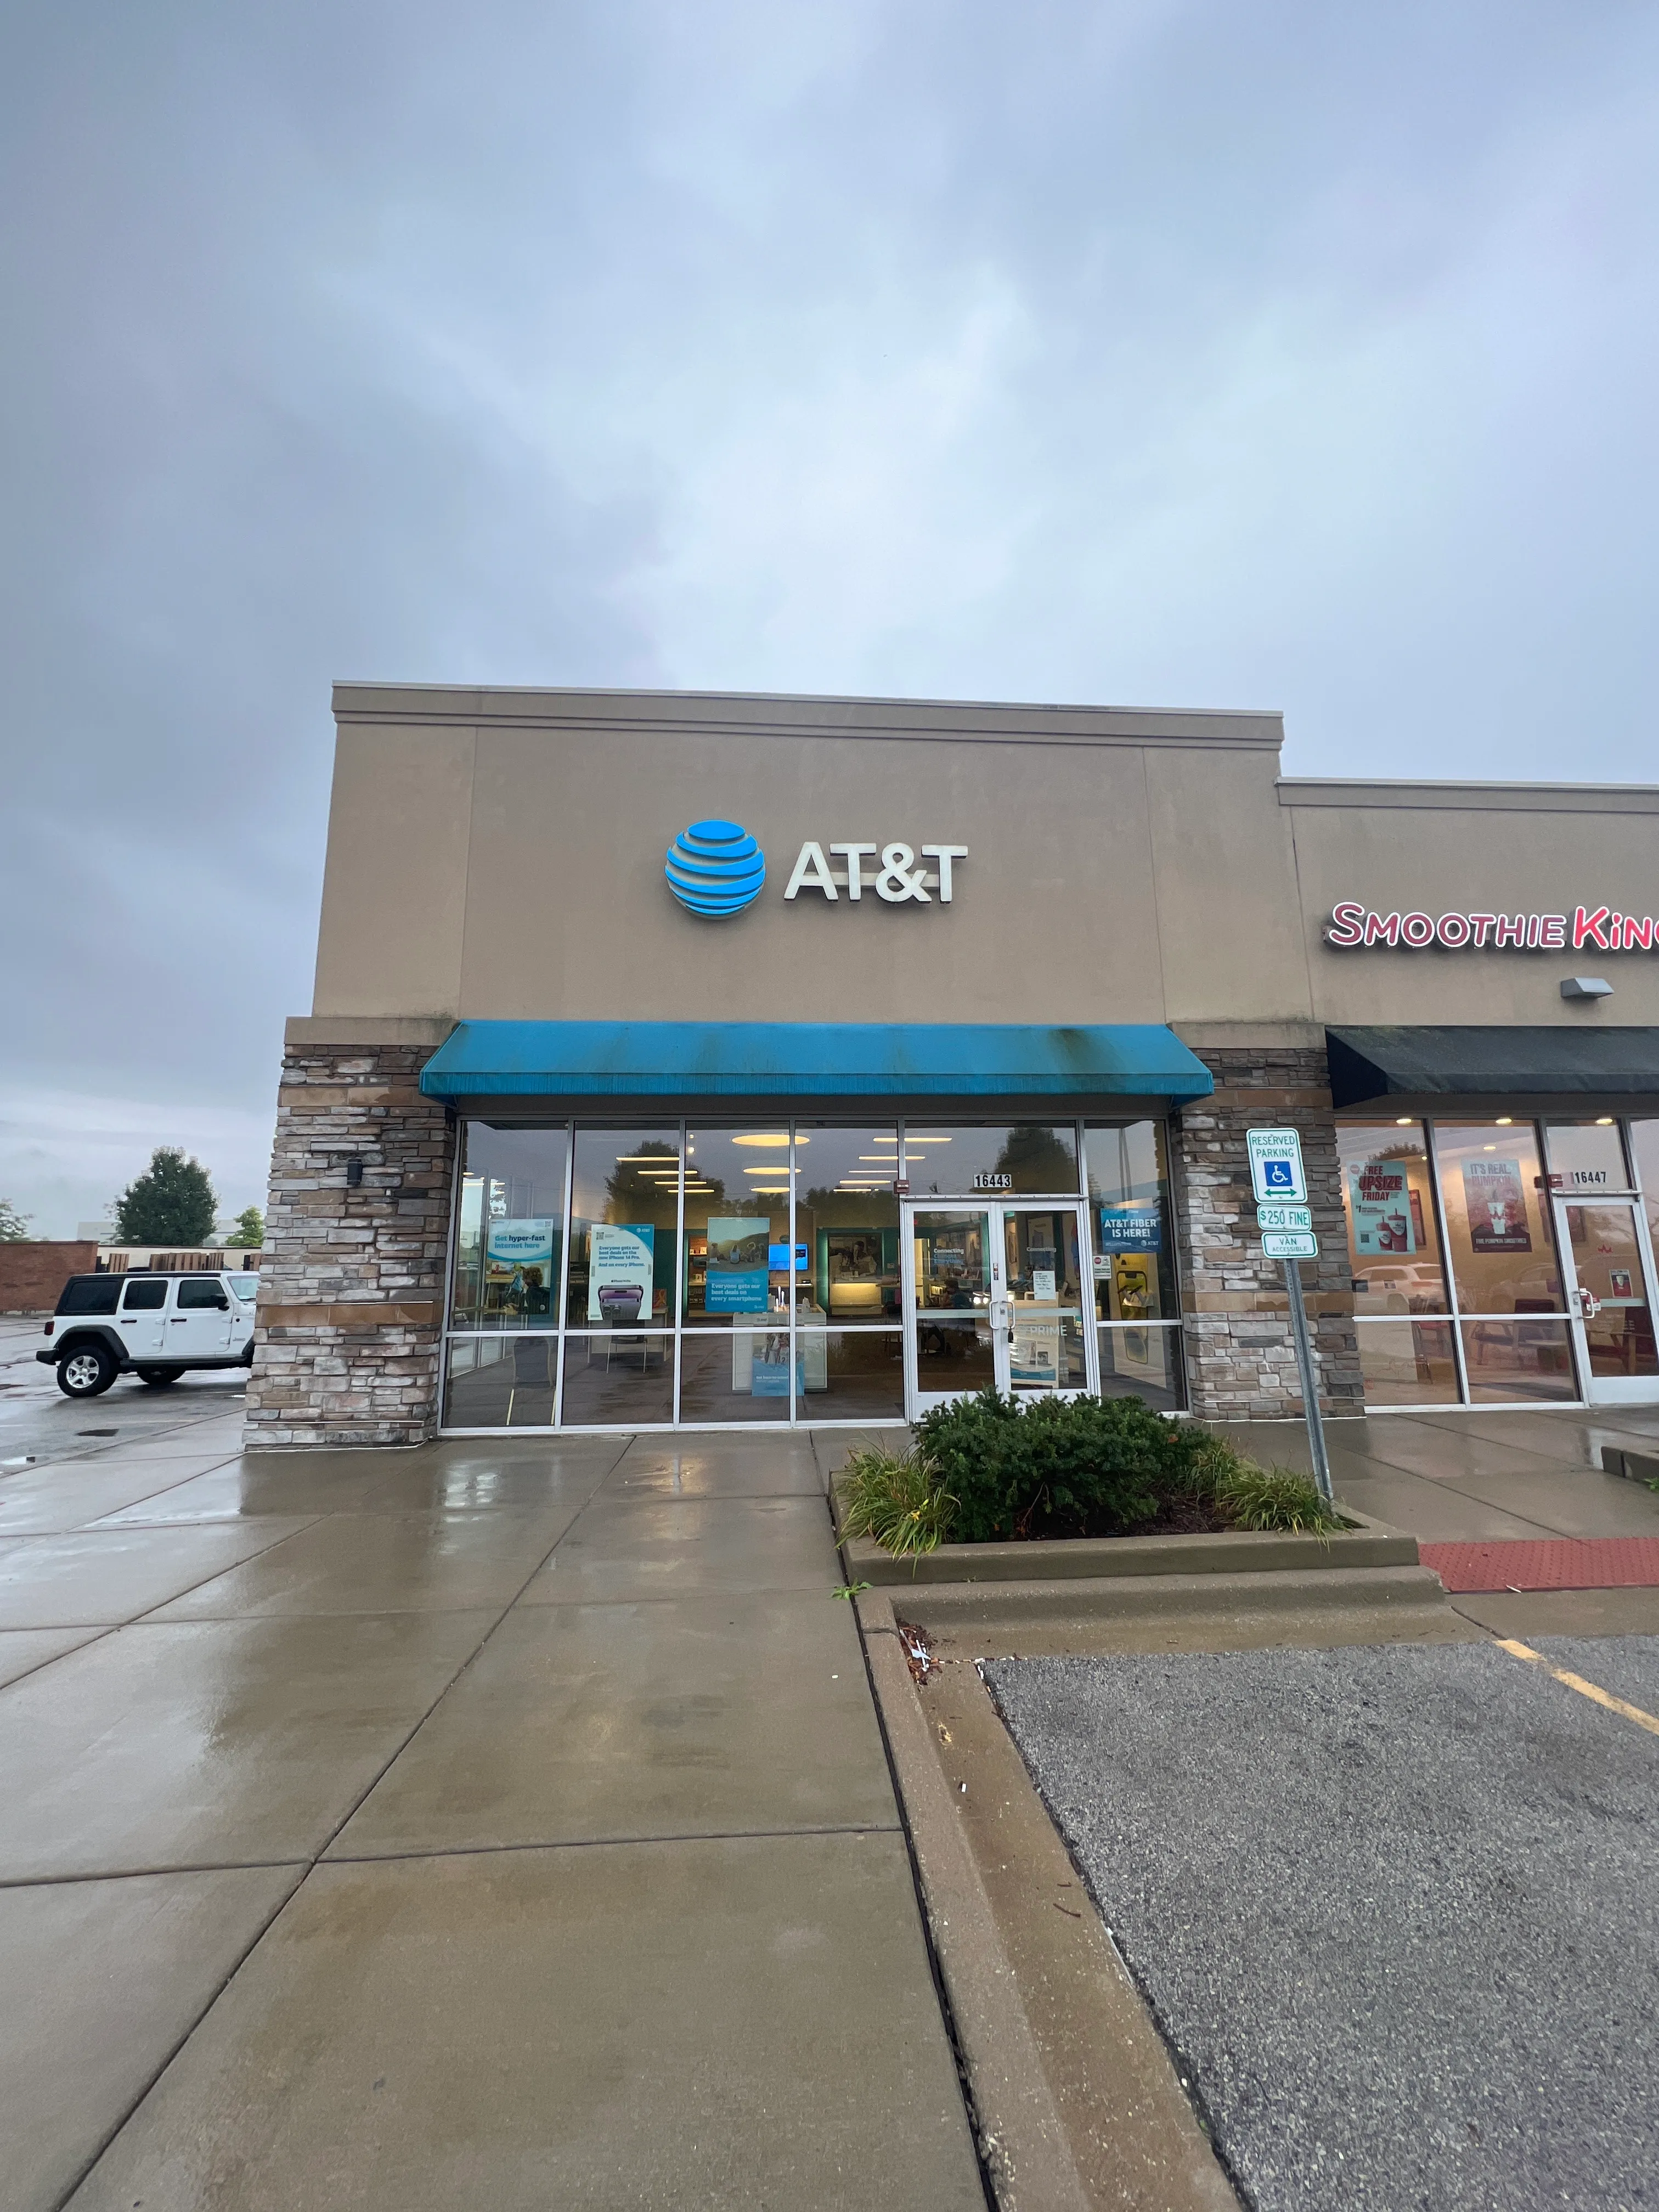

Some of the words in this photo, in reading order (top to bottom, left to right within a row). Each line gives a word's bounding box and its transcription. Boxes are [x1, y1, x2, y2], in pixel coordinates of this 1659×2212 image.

[783, 841, 968, 902] AT&T
[1329, 901, 1567, 948] SMOOTHIE
[1251, 1136, 1295, 1146] RESERVED
[1256, 1148, 1294, 1158] PARKING
[1364, 1166, 1383, 1175] FREE
[1470, 1164, 1486, 1175] IT'S
[975, 1175, 1011, 1187] 16443
[1574, 1171, 1606, 1183] 16447
[1358, 1176, 1403, 1190] UPSIZE
[1362, 1192, 1390, 1201] FRIDAY
[1104, 1218, 1128, 1228] AT&T
[1130, 1218, 1156, 1228] FIBER
[1260, 1210, 1285, 1224] $250
[1289, 1211, 1309, 1226] FINE
[1112, 1228, 1121, 1237] IS
[1123, 1228, 1150, 1237] HERE!
[1030, 1325, 1068, 1336] PRIME
